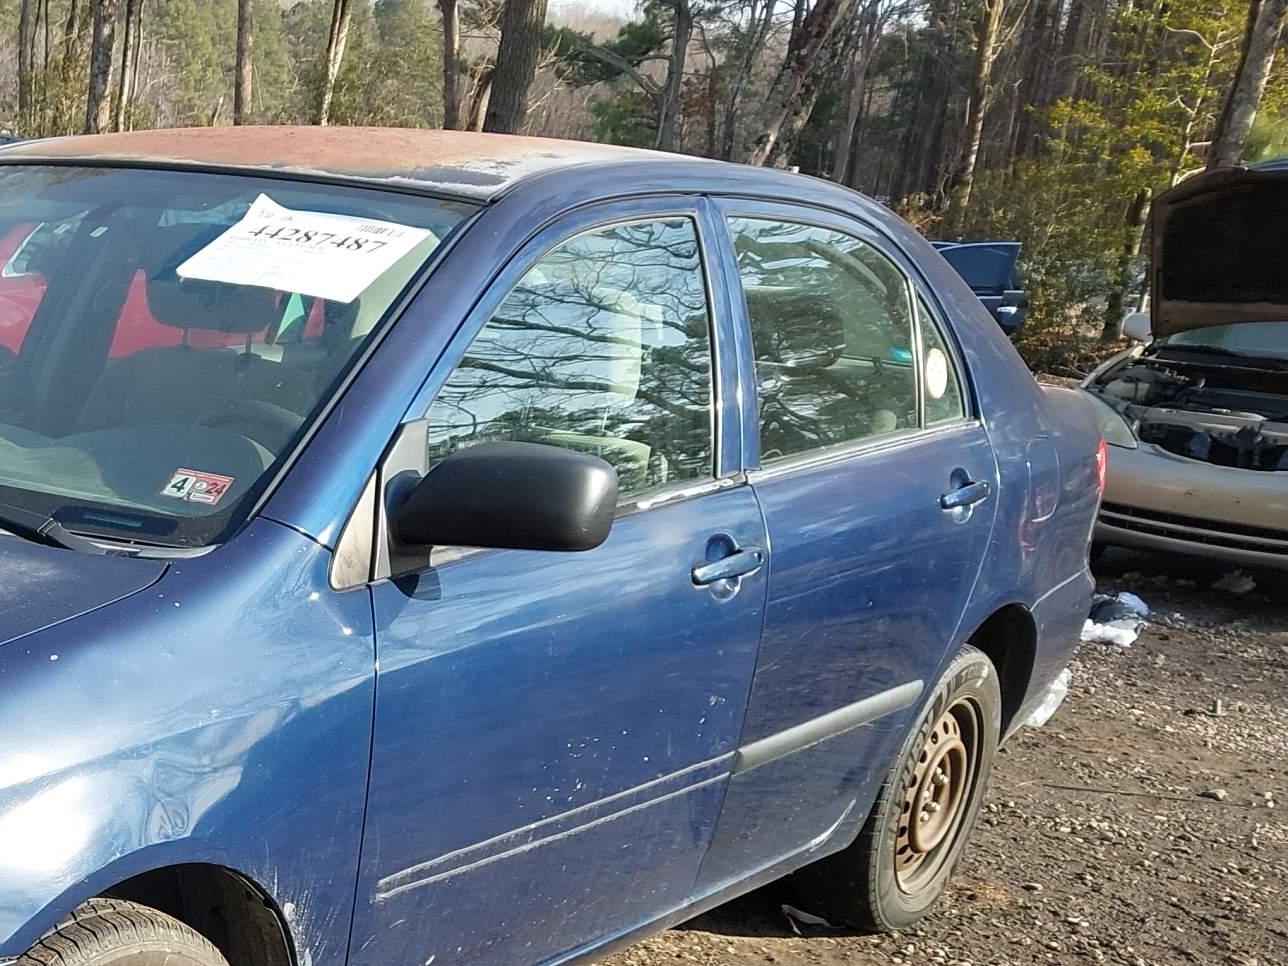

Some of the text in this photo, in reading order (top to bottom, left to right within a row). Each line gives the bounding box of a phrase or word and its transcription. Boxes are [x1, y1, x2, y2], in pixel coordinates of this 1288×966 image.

[248, 224, 388, 254] 44287487
[170, 476, 228, 497] 4 24
